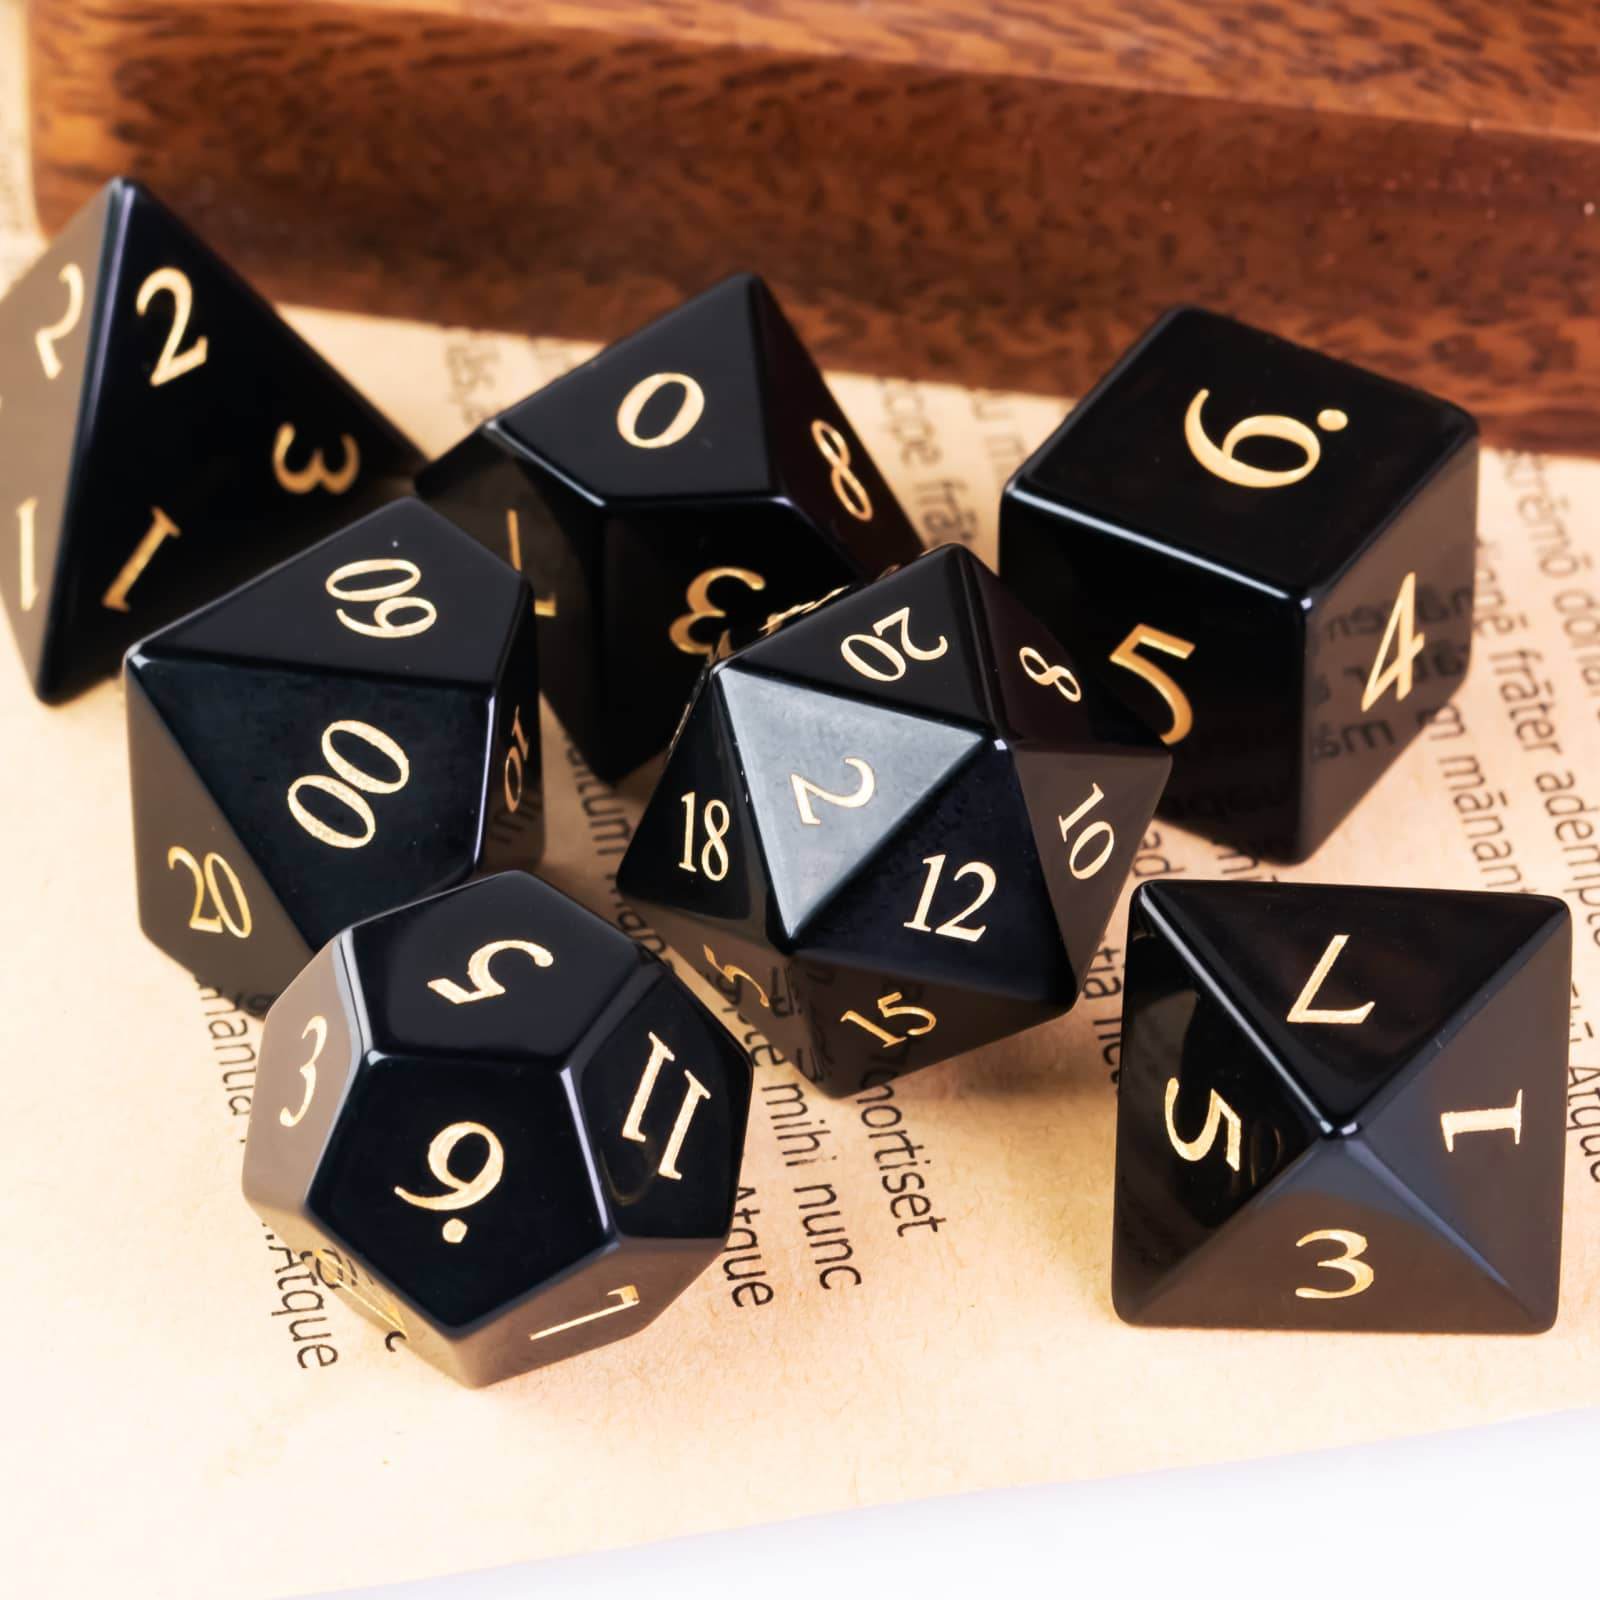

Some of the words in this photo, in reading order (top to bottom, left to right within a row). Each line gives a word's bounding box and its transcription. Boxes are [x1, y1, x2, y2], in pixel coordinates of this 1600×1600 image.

[35, 262, 85, 380] 2
[136, 267, 208, 386] 2
[617, 372, 705, 449] 0
[272, 423, 358, 493] 3
[811, 419, 872, 521] 8
[16, 497, 39, 612] 1
[103, 507, 181, 612] 1
[669, 566, 767, 656] 3
[840, 606, 949, 682] 20
[1361, 572, 1425, 712] 4
[1019, 646, 1082, 703] 8
[1109, 624, 1195, 745] 5
[1488, 648, 1564, 757] frāter
[287, 720, 410, 849] 00
[790, 758, 875, 825] 2
[1058, 782, 1115, 880] 10
[678, 791, 730, 882] 18
[167, 846, 252, 939] 20
[903, 854, 997, 942] 12
[427, 939, 554, 1005] 5
[1286, 934, 1376, 1025] 7
[840, 991, 937, 1048] 15
[279, 1015, 328, 1128] 3
[622, 1031, 711, 1180] 11
[762, 1081, 832, 1169] mihi
[1164, 1077, 1242, 1172] 5
[1440, 1088, 1523, 1153] 1
[793, 1183, 862, 1290] nunc
[1295, 1229, 1374, 1299] 3
